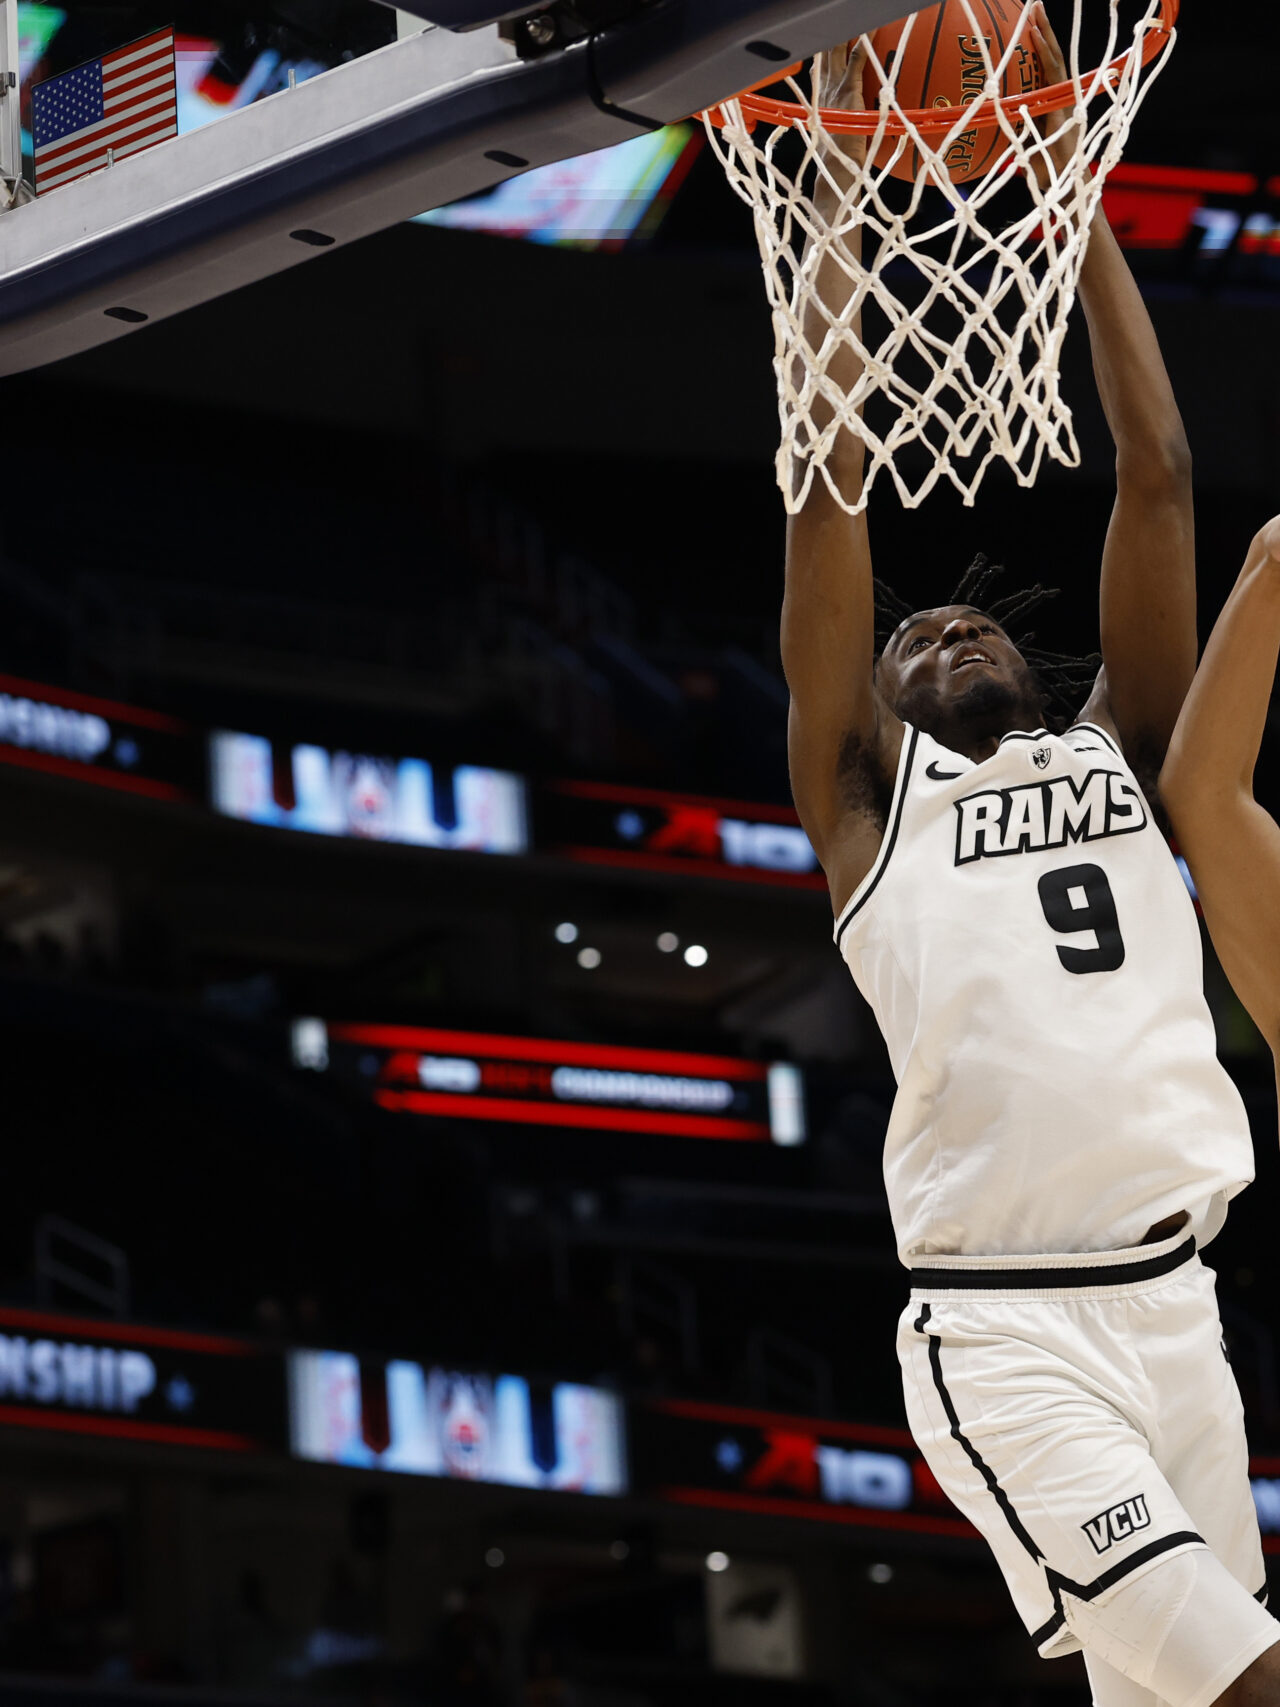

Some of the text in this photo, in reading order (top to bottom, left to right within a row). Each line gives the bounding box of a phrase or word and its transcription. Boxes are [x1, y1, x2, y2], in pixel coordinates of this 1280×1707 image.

[954, 768, 1148, 868] RAMS
[1037, 863, 1125, 974] 9
[1081, 1493, 1151, 1555] VCU
